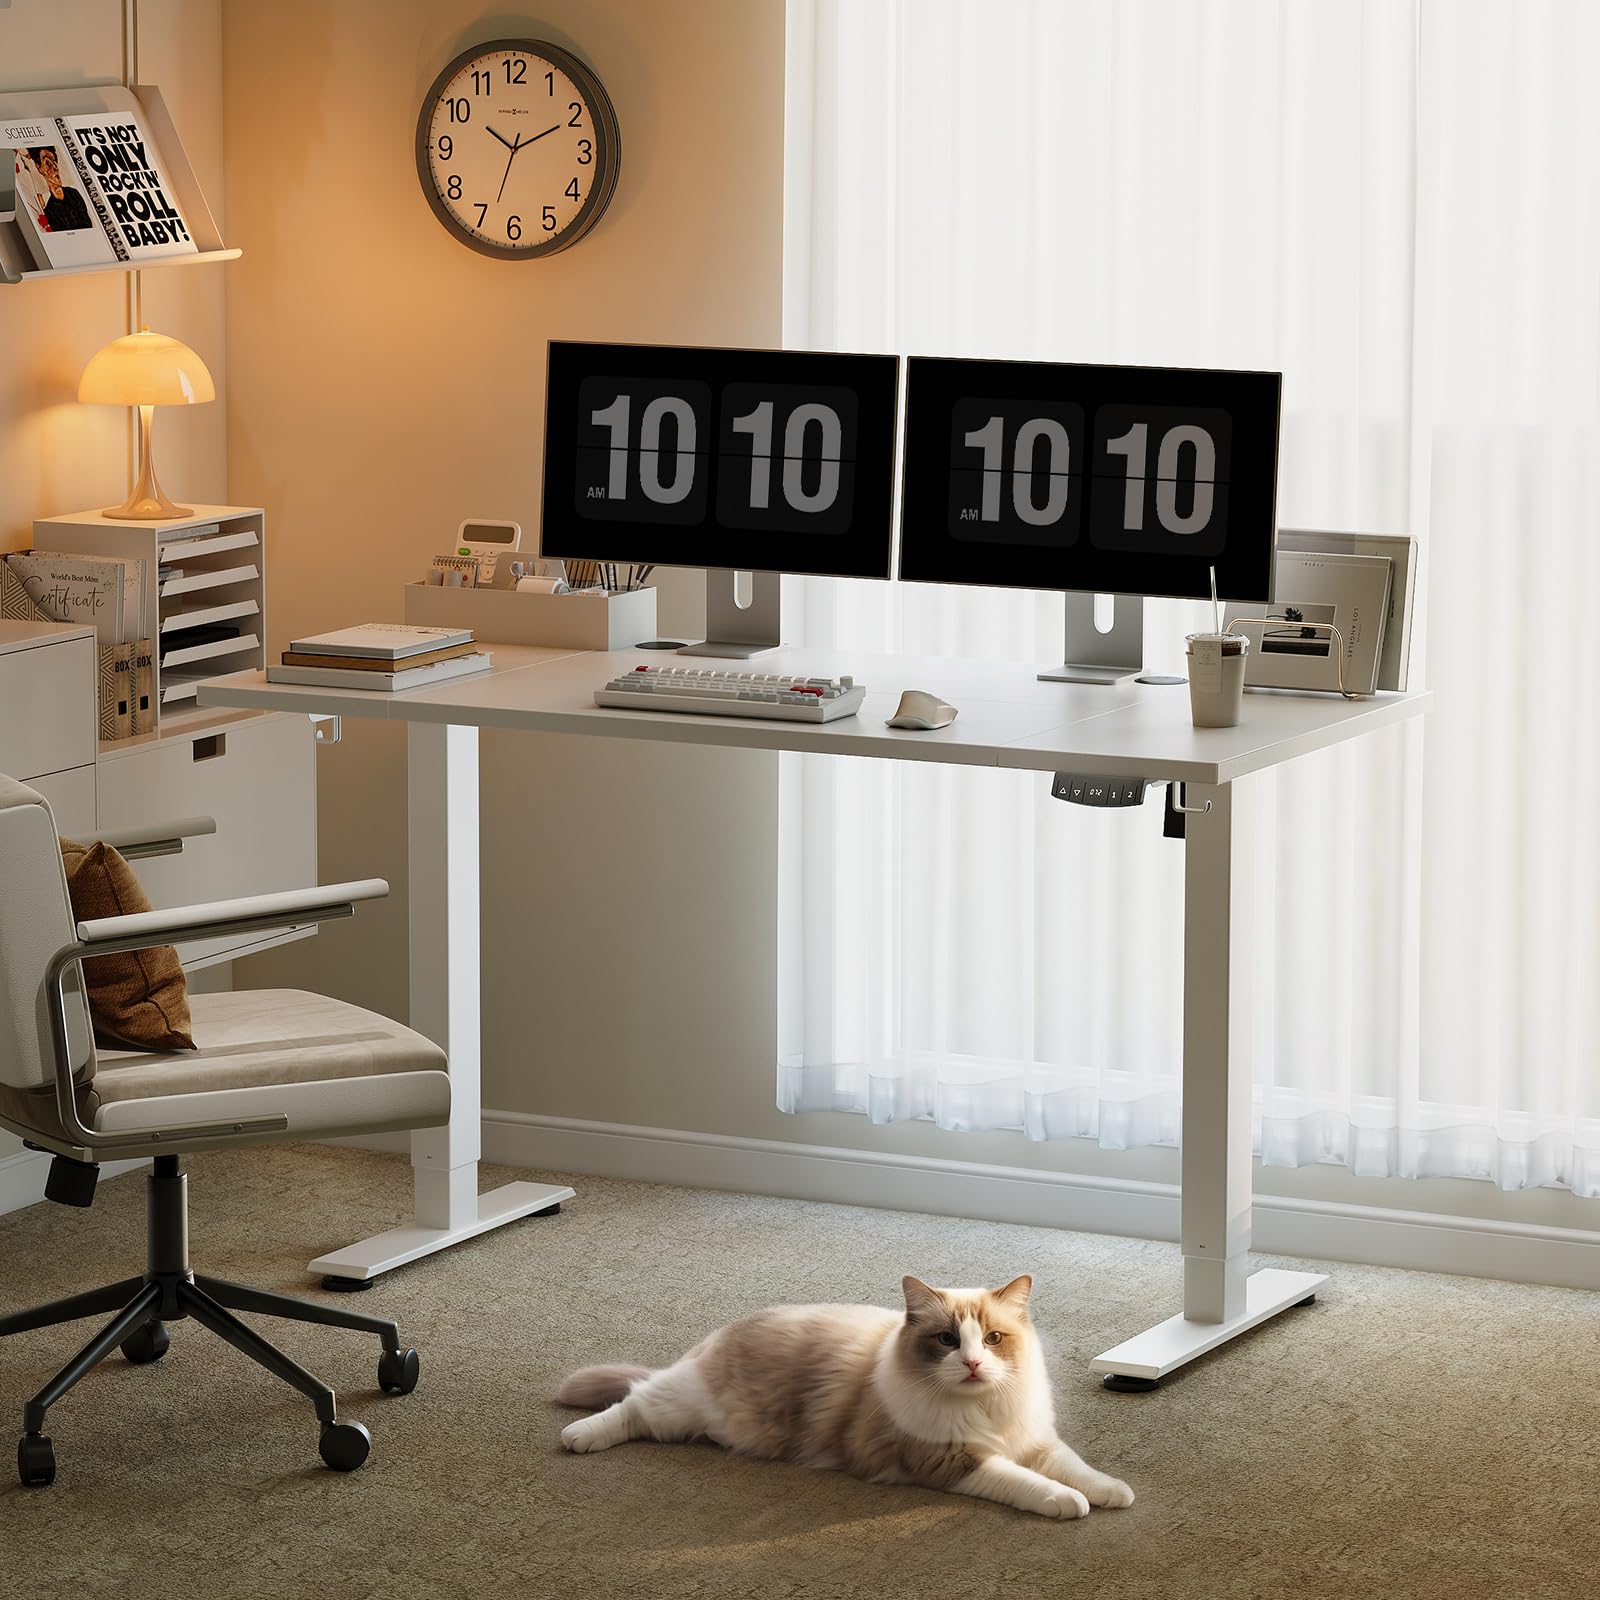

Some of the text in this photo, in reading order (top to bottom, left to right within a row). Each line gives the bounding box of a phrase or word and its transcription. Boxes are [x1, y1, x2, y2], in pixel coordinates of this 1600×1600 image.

[470, 70, 491, 96] 11
[501, 59, 527, 84] 12
[544, 72, 554, 96] 1
[445, 97, 471, 123] 10
[567, 102, 582, 127] 2
[4, 126, 45, 139] SCHIELE
[74, 127, 107, 146] IT'S
[104, 124, 140, 143] NOT
[85, 141, 150, 174] ONLY
[438, 135, 453, 160] 9
[577, 139, 592, 164] 3
[447, 175, 462, 200] 8
[564, 177, 581, 202] 4
[106, 189, 179, 223] ROLL
[473, 203, 488, 228] 7
[542, 206, 557, 231] 5
[120, 218, 190, 248] BABY!
[506, 215, 522, 240] 6
[591, 394, 842, 513] 10 10
[964, 416, 1216, 535] 10 10
[586, 486, 605, 499] AM
[959, 508, 978, 521] AM
[50, 572, 99, 583] World's Best Mom
[114, 660, 130, 673] BOX
[136, 655, 152, 669] BOX
